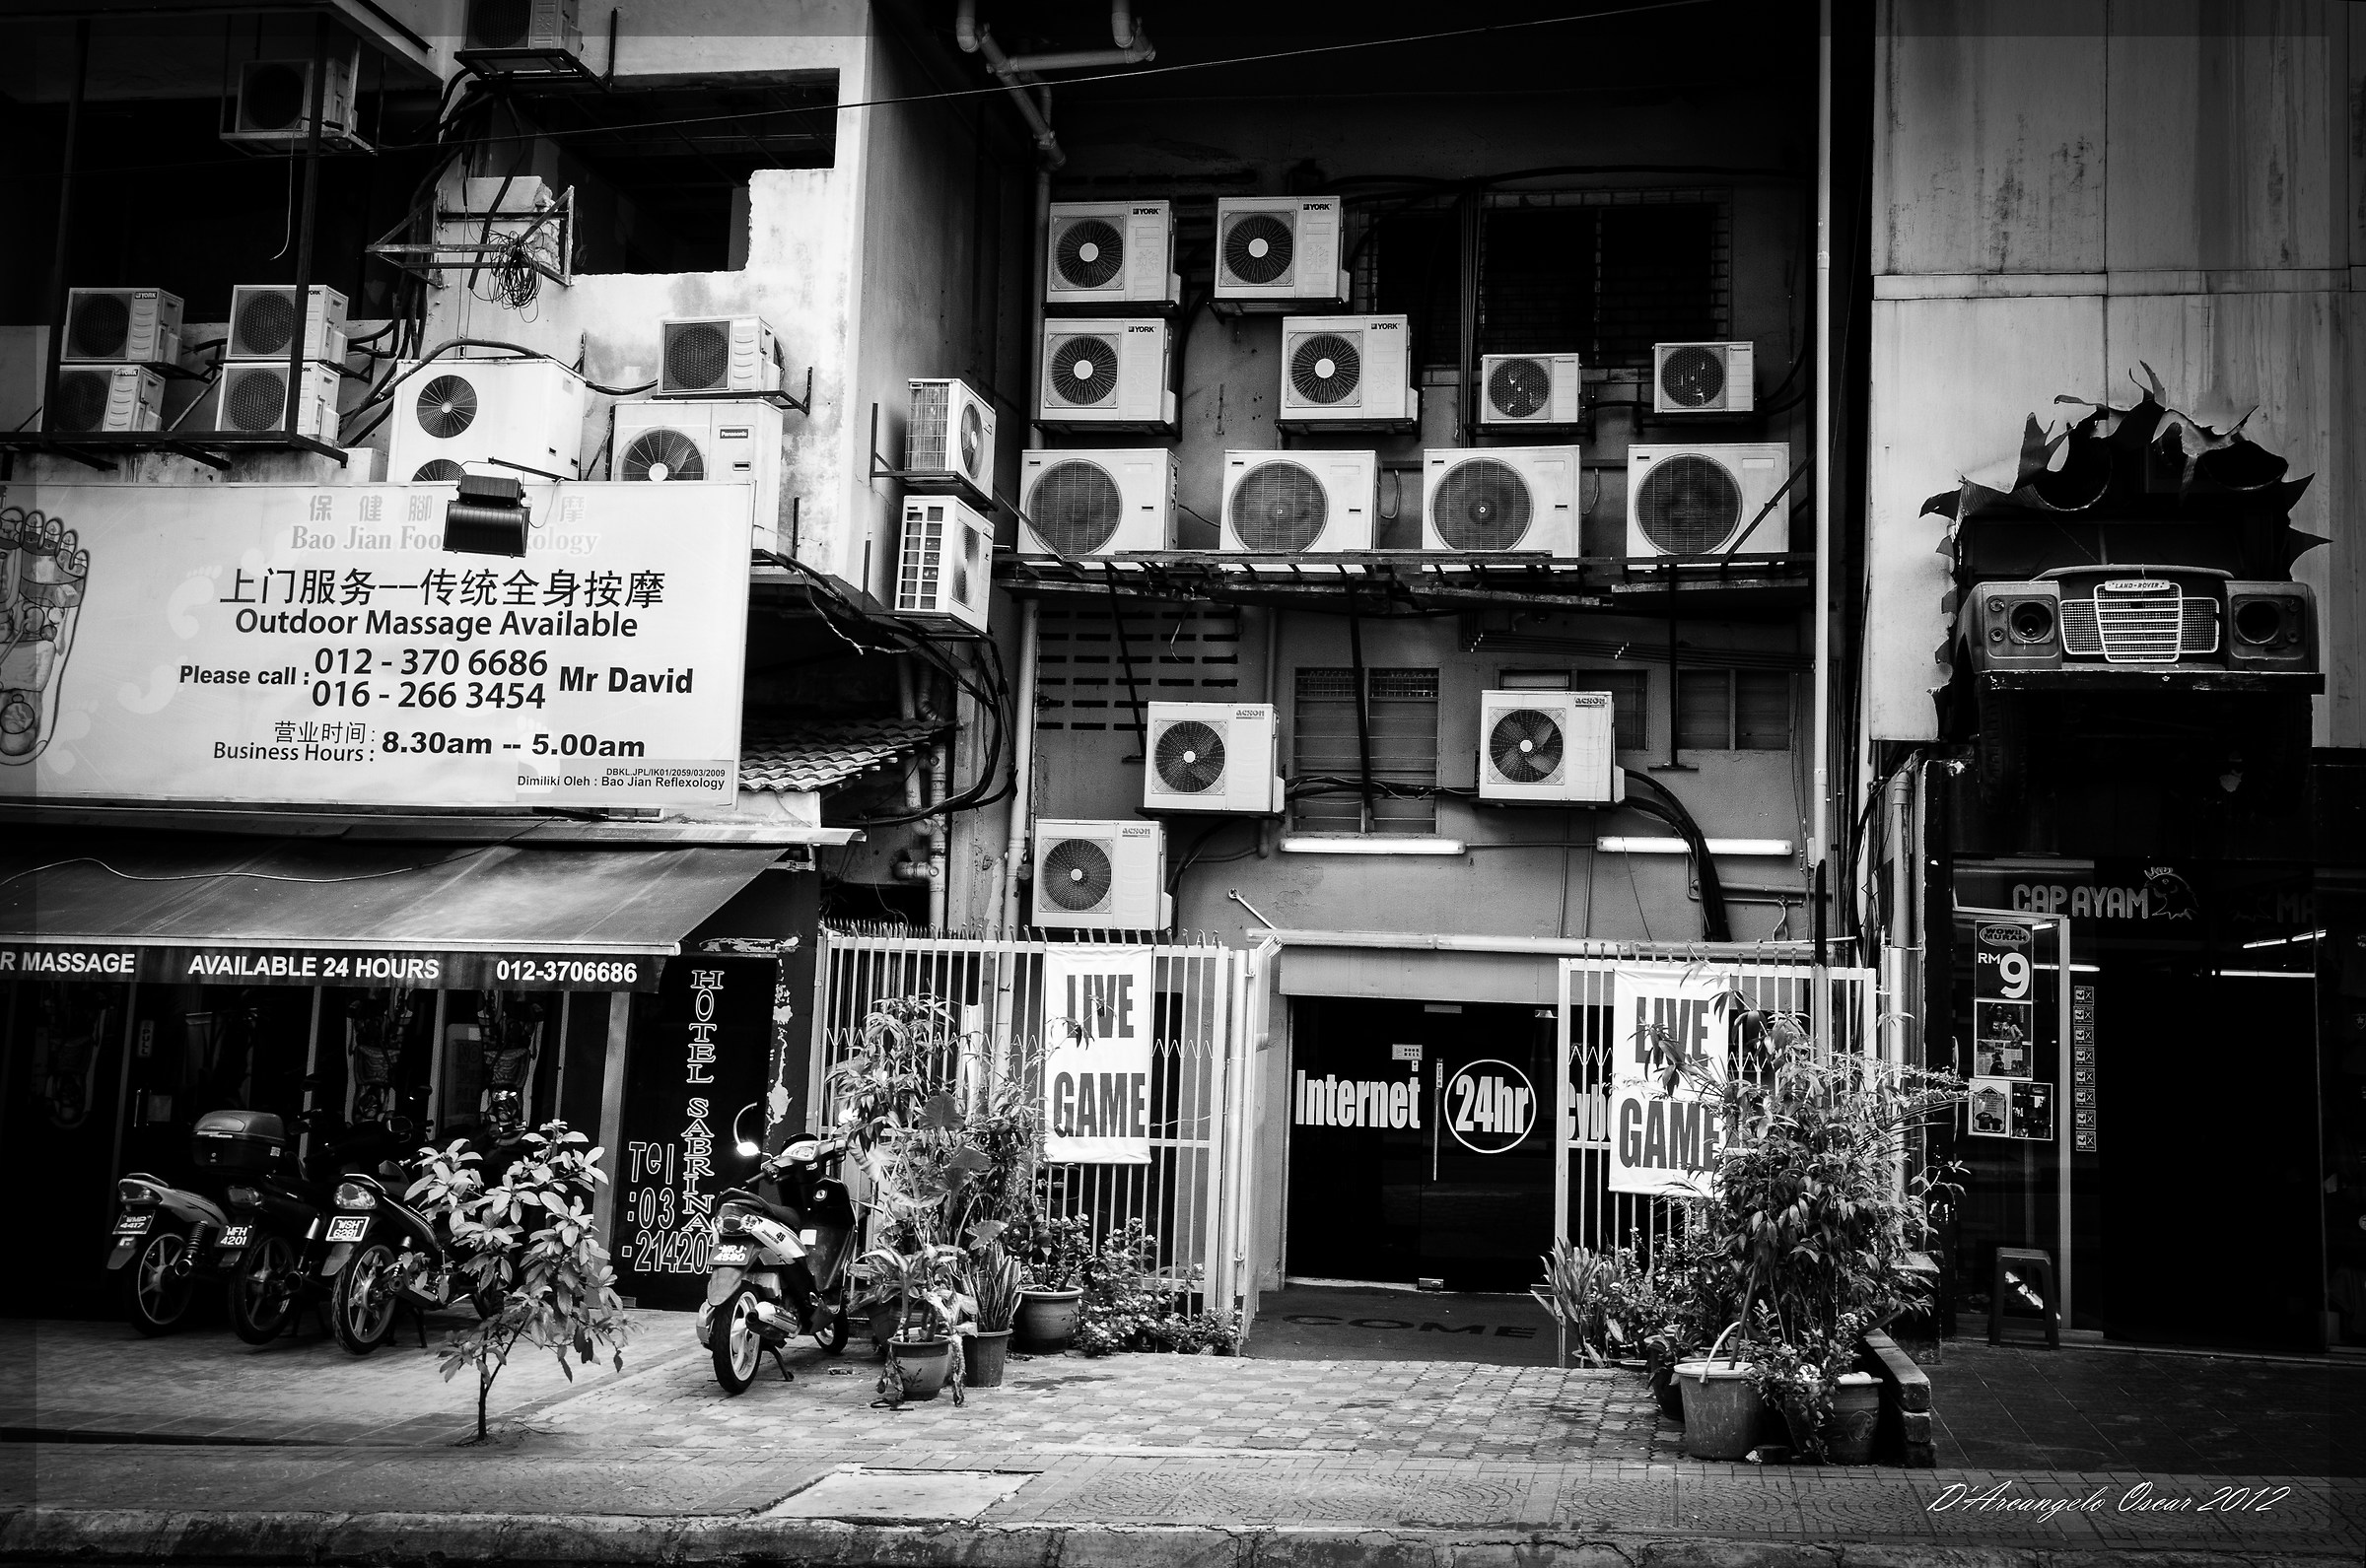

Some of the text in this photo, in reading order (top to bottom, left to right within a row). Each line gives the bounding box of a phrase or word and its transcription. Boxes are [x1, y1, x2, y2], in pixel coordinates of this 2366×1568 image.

[291, 525, 336, 550] Bao
[343, 525, 391, 550] Jian
[399, 525, 444, 550] Foo
[237, 608, 638, 642] Outdoor Massage Available
[179, 665, 250, 685] Please
[315, 648, 373, 675] 012
[400, 648, 459, 676] 370
[468, 649, 548, 677] 6686
[560, 666, 694, 694] Mr David
[313, 681, 371, 708] 016
[398, 682, 456, 709] 266
[465, 682, 546, 710] 3454
[214, 741, 299, 762] Business
[382, 731, 492, 755] 8.30am
[531, 733, 645, 758] 5.00am
[518, 776, 560, 786] Dimiliki
[564, 776, 591, 786] Oleh
[602, 777, 624, 787] Bao
[628, 777, 652, 787] Jian
[657, 777, 726, 790] Reflexology
[2012, 883, 2149, 920] CAP AYAM
[22, 951, 136, 974] MASSAGE
[187, 955, 316, 977] AVAILABLE
[322, 956, 349, 978] 24
[355, 957, 440, 979] HOURS
[496, 959, 638, 983] 012-3706686
[1067, 974, 1135, 1039] LIVE
[685, 970, 725, 1084] HOTEL
[1635, 996, 1709, 1066] LIVE
[1053, 1071, 1146, 1138] GAME
[1295, 1069, 1421, 1129] Internet
[1456, 1074, 1529, 1134] 24hr
[1619, 1098, 1720, 1172] GAME
[629, 1141, 675, 1186] Tel
[680, 1097, 716, 1233] SABRINA
[226, 1226, 248, 1236] WFH
[339, 1220, 361, 1229] WSH
[220, 1235, 247, 1246] 4201
[1283, 1315, 1537, 1339] COME
